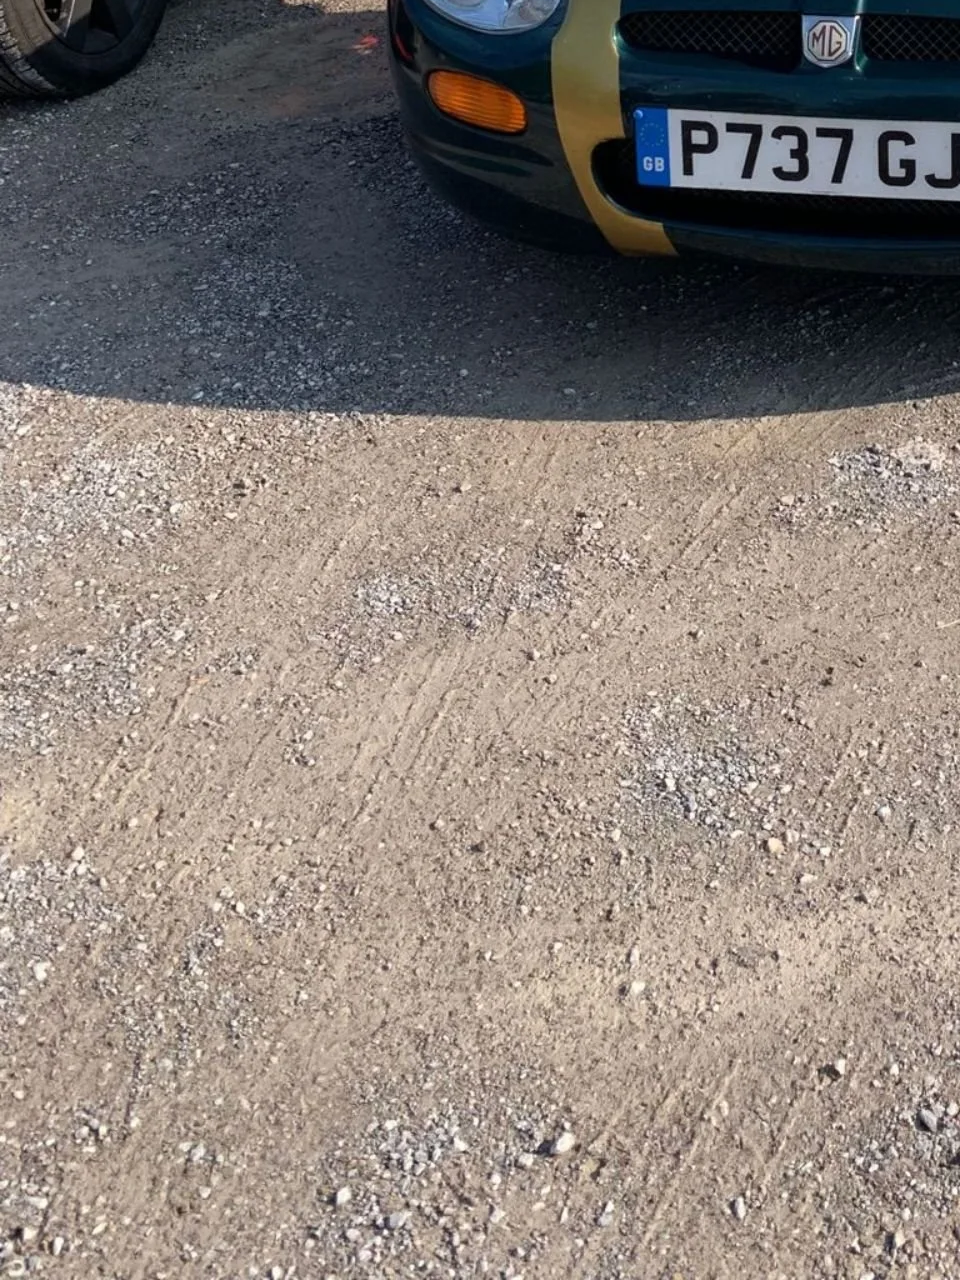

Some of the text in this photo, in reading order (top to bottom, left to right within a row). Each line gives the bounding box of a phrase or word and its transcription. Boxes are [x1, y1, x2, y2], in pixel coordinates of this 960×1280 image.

[811, 25, 844, 58] MG
[642, 156, 665, 172] GB
[680, 119, 855, 184] P737
